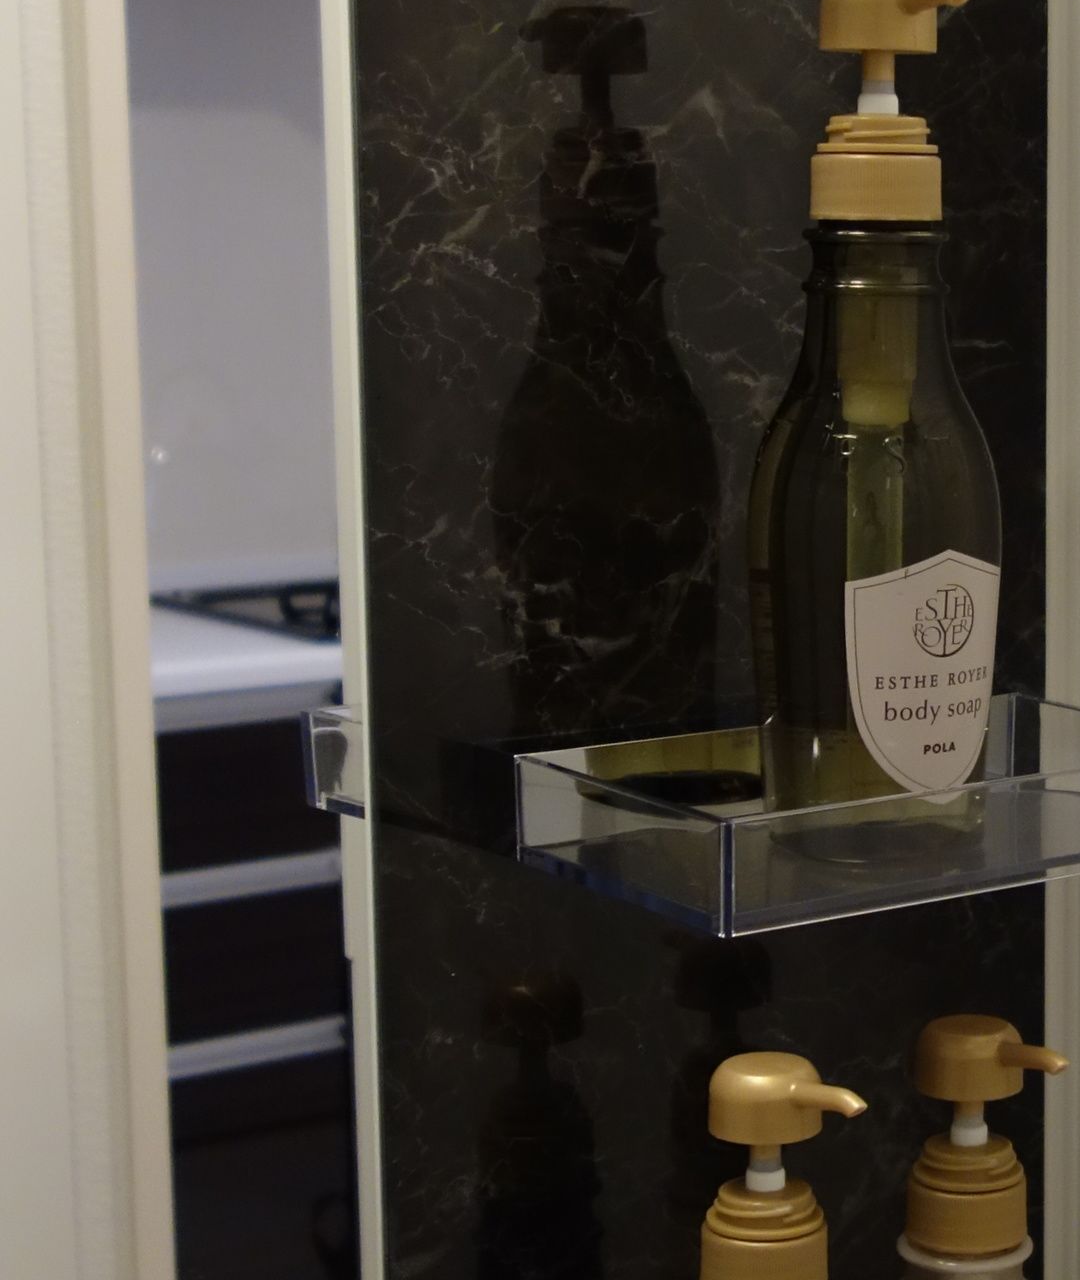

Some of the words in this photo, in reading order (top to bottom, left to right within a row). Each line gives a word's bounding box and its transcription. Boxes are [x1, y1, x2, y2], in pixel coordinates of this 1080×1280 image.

[874, 674, 938, 690] ESTHE
[948, 666, 987, 686] ROYER
[885, 699, 941, 726] body
[947, 697, 982, 718] soap
[923, 741, 956, 755] POLA
